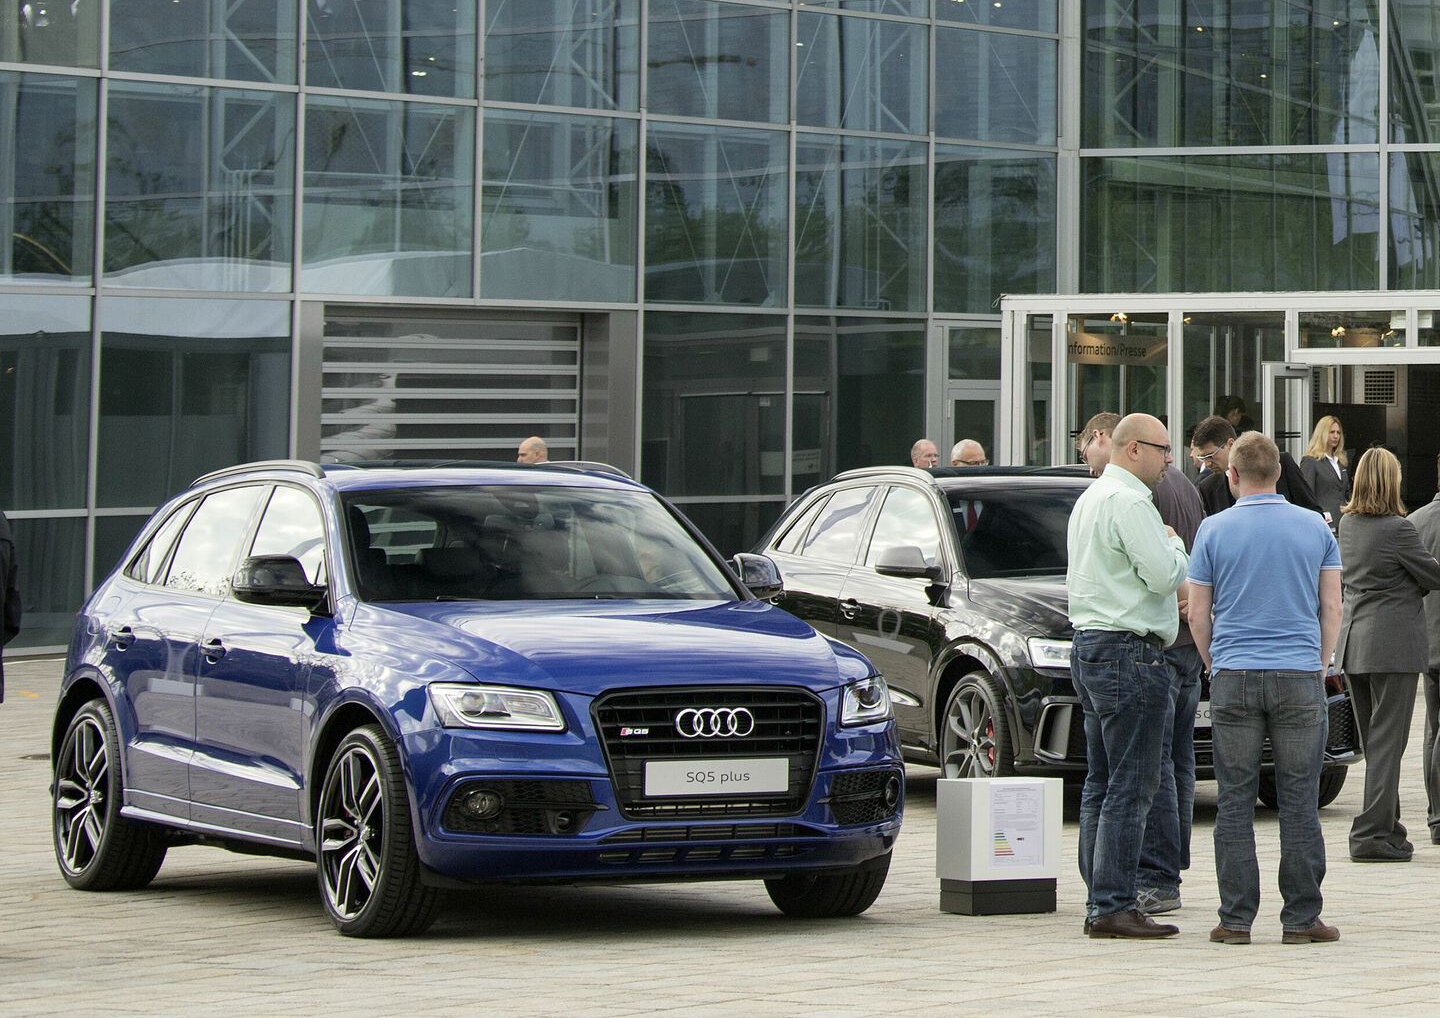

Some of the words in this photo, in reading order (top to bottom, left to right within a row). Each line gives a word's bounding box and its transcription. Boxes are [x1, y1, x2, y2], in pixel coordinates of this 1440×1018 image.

[1067, 342, 1148, 358] nformation/Presse
[686, 771, 715, 784] SQ5
[720, 771, 751, 785] plus
